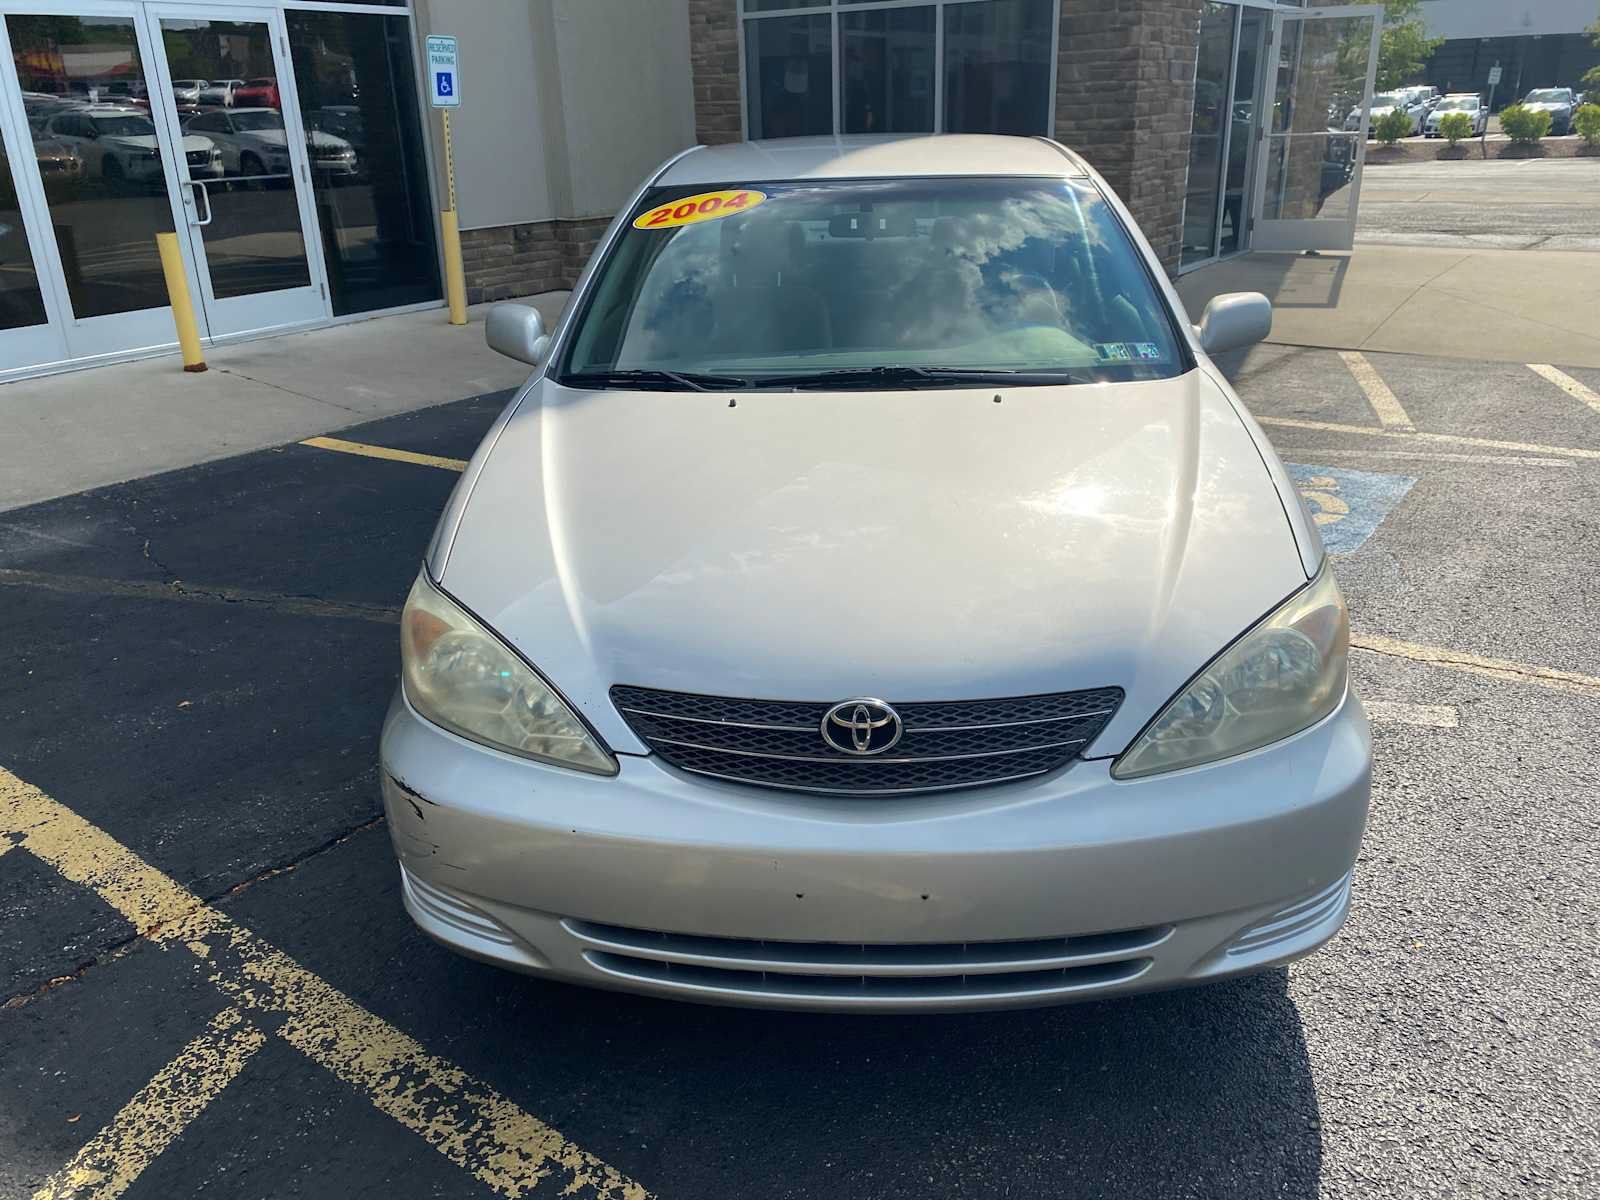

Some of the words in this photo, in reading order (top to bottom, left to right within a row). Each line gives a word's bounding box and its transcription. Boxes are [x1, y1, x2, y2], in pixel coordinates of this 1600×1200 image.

[430, 43, 456, 53] RESERVED
[432, 55, 455, 65] PARKING
[646, 191, 749, 227] 2004
